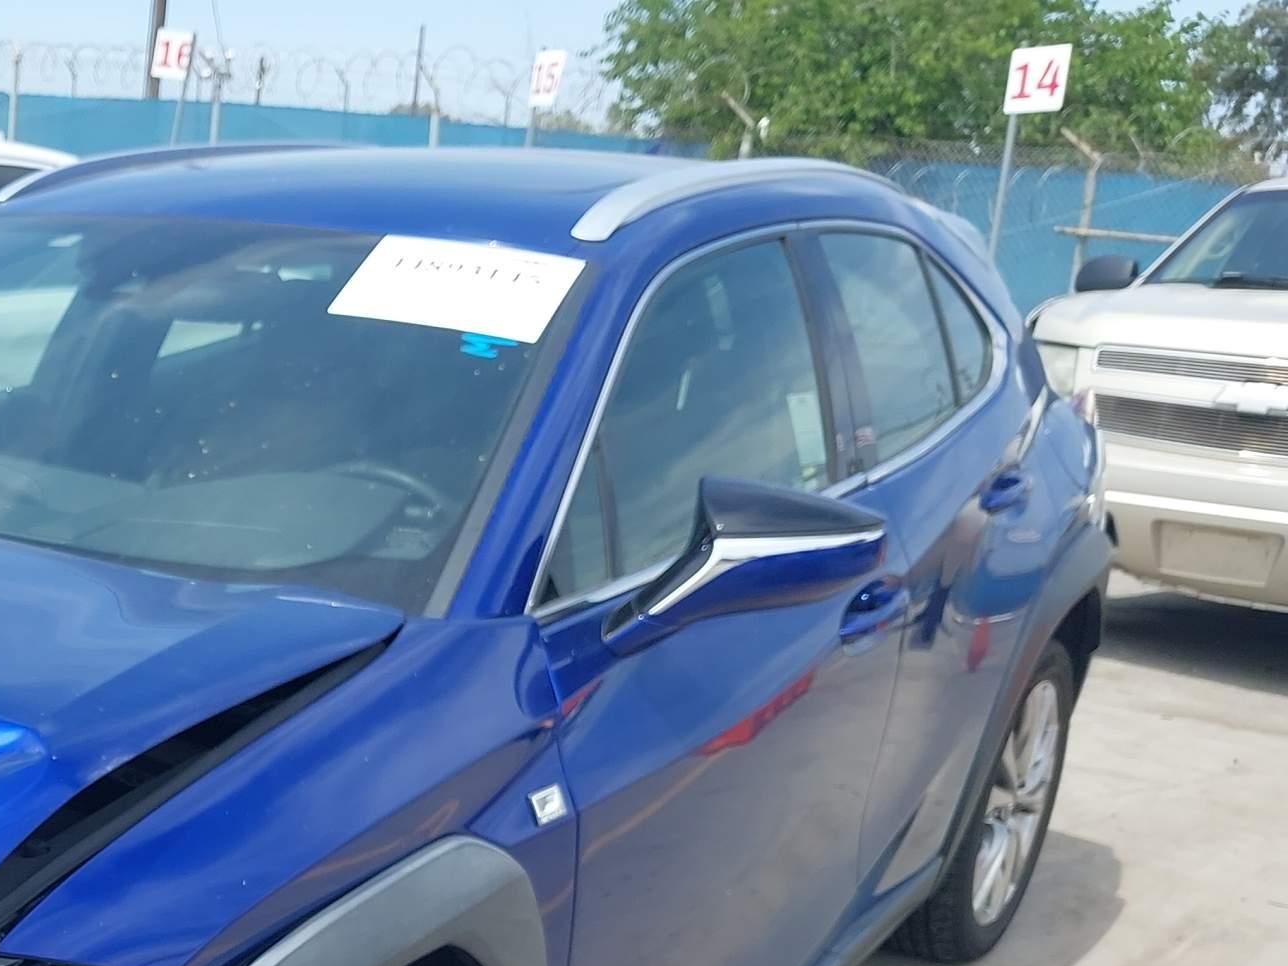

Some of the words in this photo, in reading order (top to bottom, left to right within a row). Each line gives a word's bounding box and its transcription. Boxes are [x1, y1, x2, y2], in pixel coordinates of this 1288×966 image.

[159, 41, 193, 69] 16
[534, 61, 559, 94] 15
[1011, 58, 1060, 99] 14
